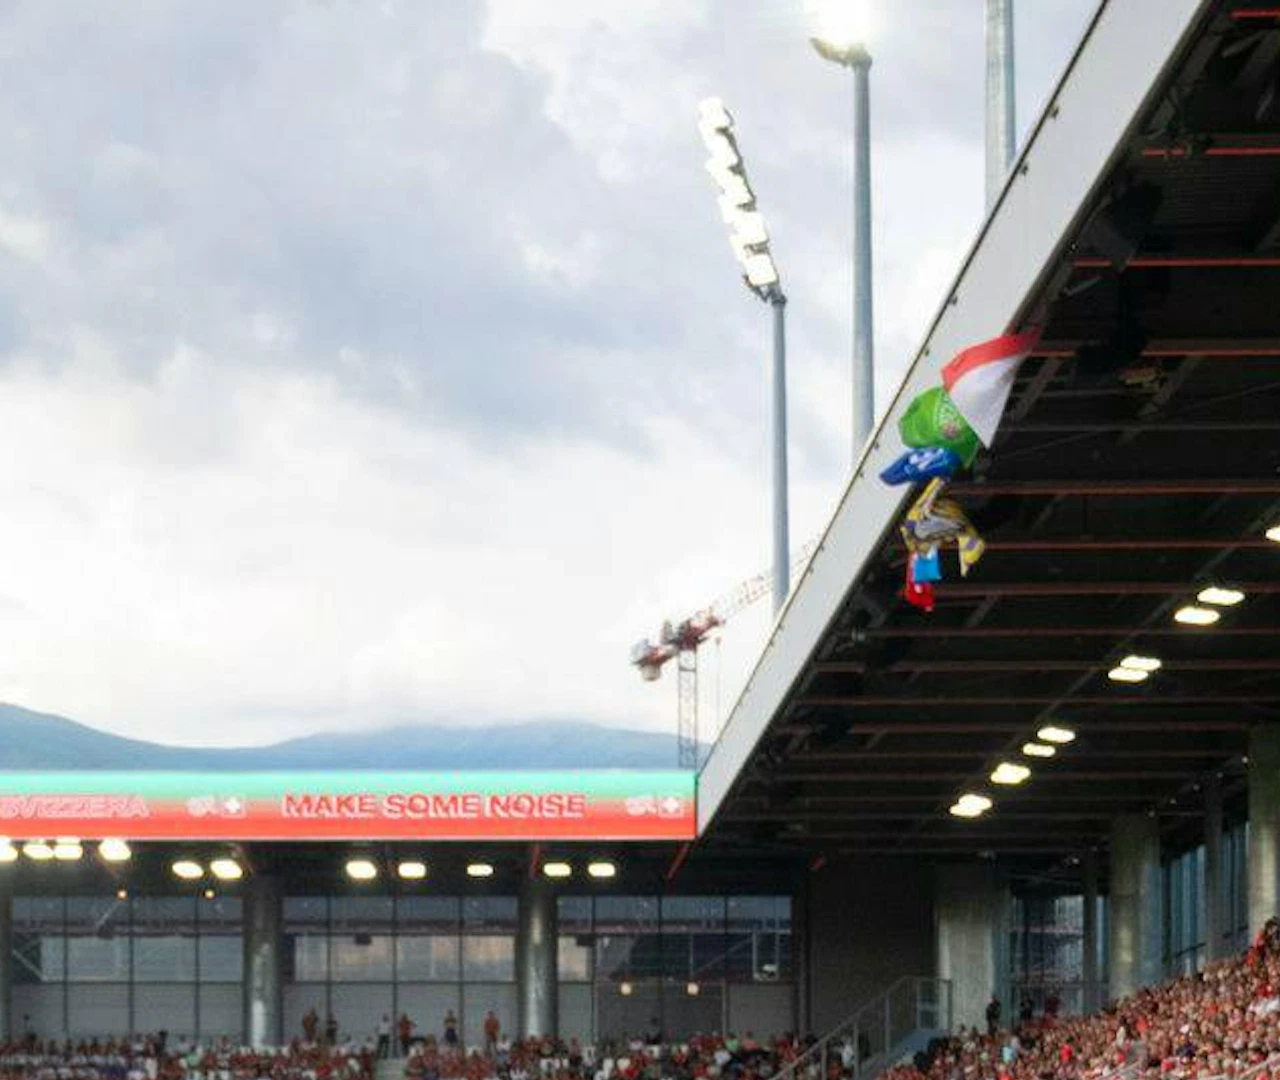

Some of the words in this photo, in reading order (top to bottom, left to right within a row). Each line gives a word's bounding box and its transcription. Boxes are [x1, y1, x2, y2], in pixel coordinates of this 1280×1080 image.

[281, 794, 375, 818] MAKE
[380, 794, 480, 819] SOME
[483, 793, 586, 818] NOISE
